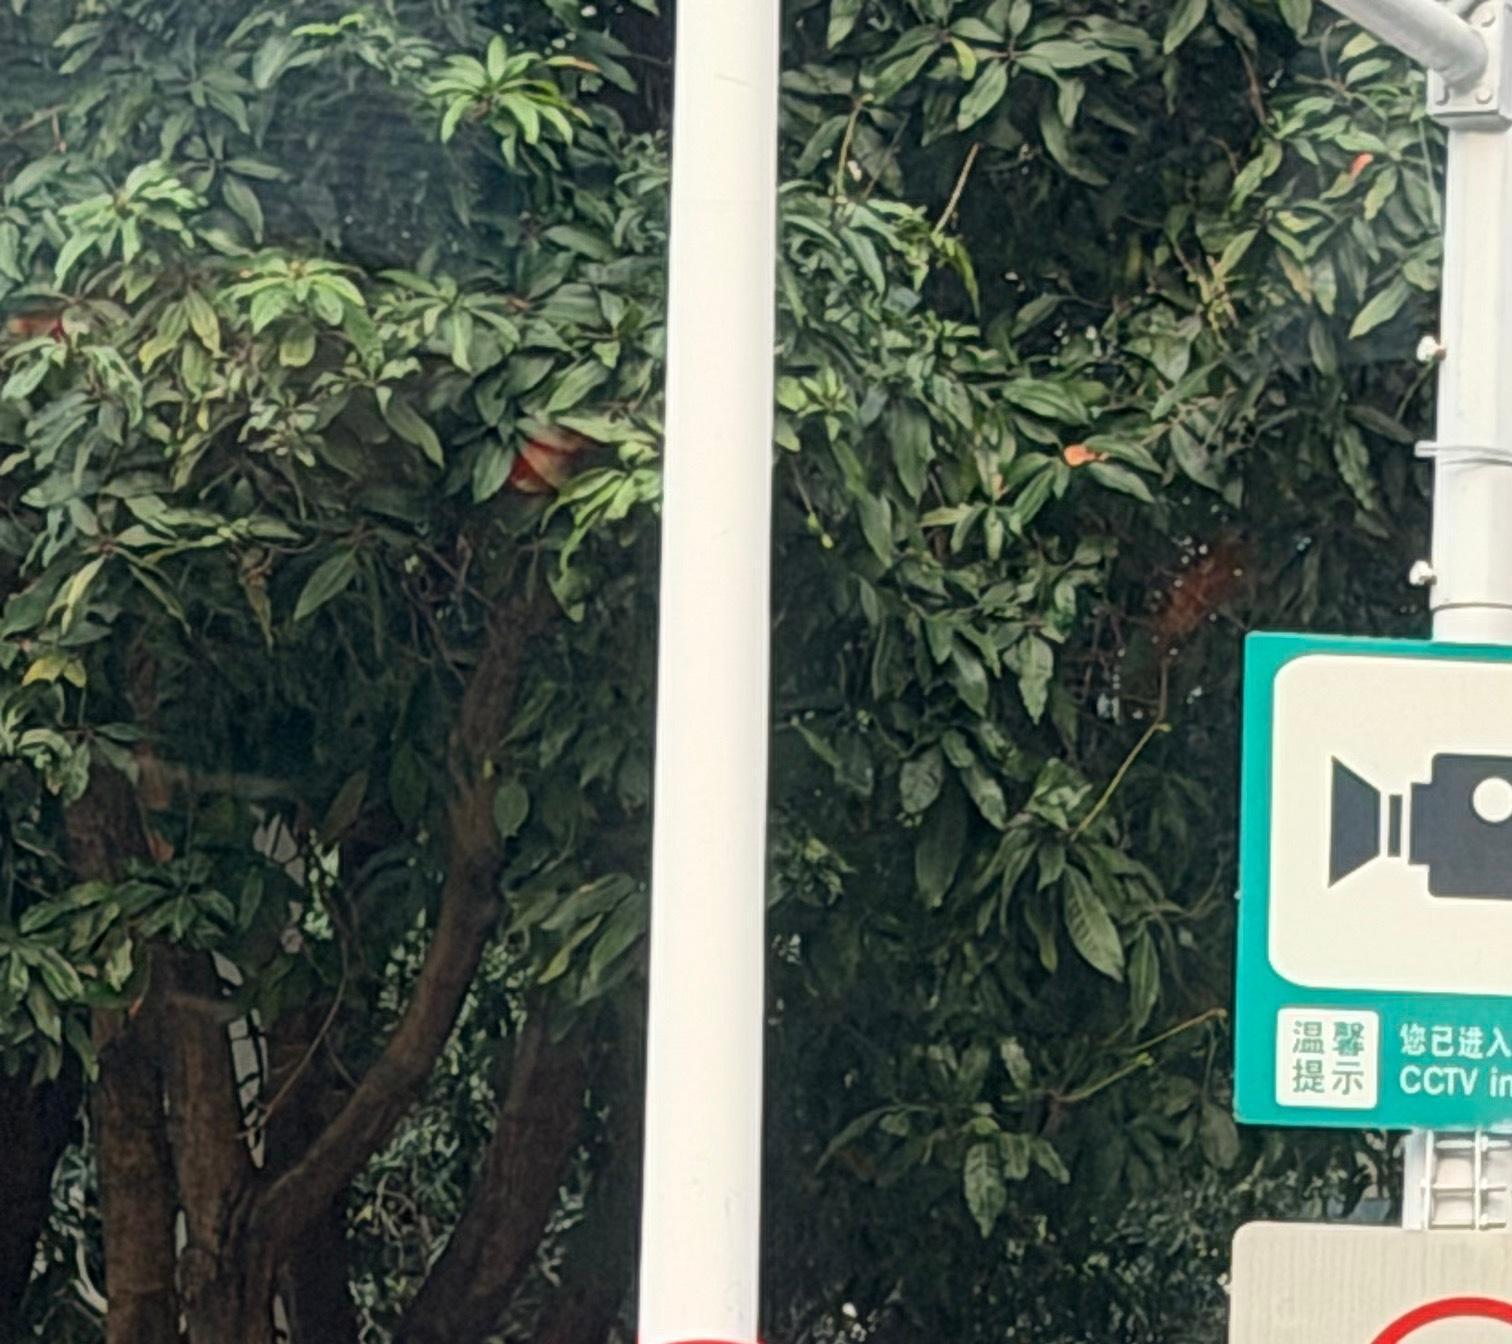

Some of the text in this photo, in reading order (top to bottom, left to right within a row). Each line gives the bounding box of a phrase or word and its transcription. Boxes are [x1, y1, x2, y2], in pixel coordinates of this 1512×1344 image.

[1292, 1019, 1365, 1057] 温馨
[1292, 1059, 1364, 1095] 提示
[1399, 1065, 1479, 1096] CCTV
